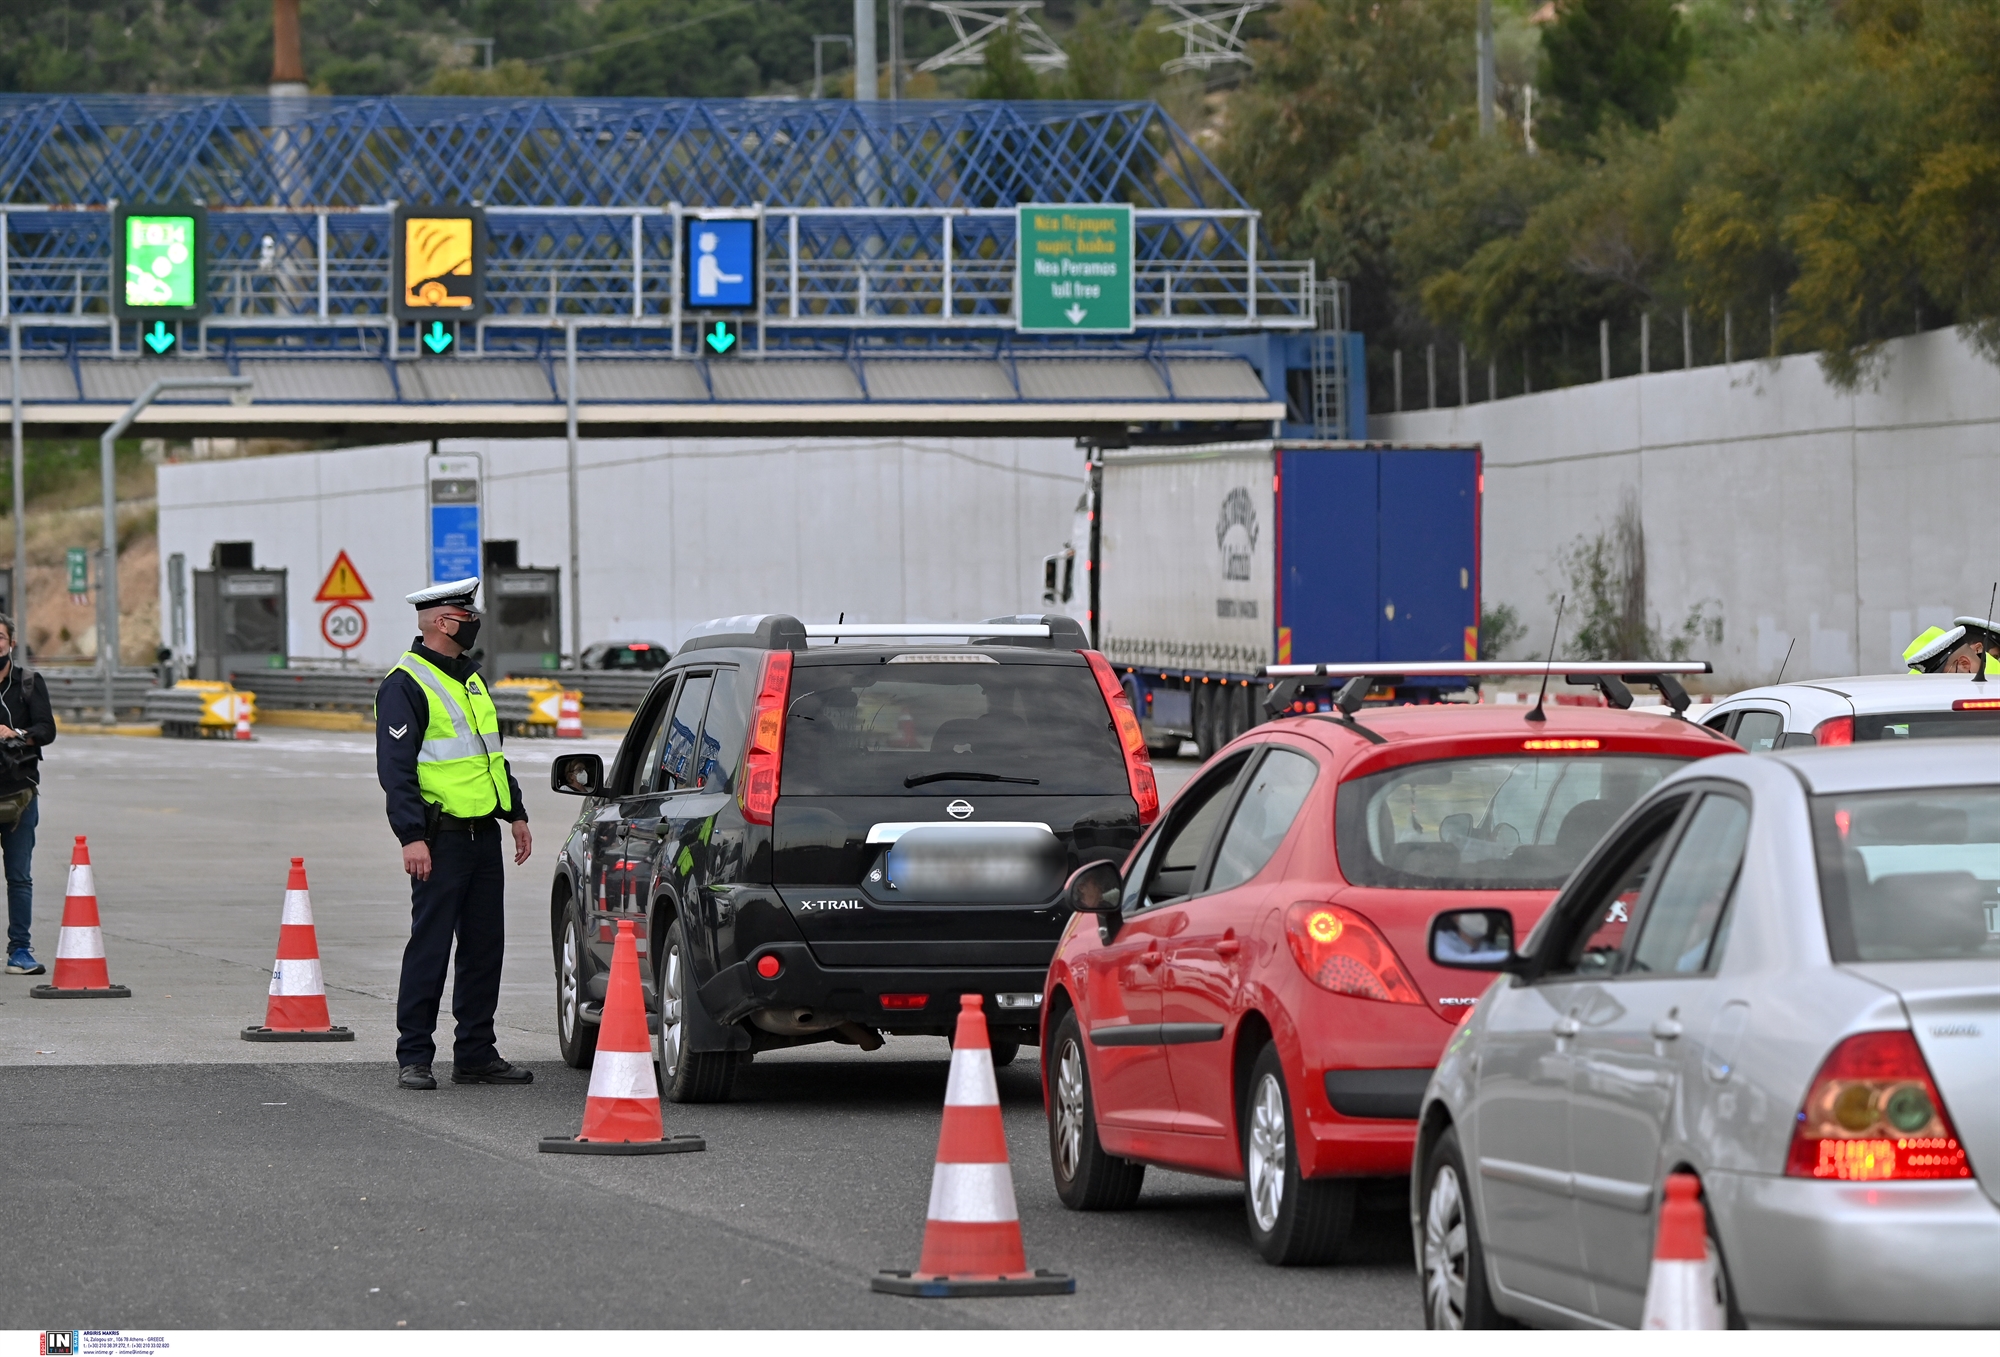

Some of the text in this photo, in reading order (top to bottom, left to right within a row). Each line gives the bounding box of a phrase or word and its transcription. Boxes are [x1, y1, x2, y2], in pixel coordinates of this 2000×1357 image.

[1034, 258, 1118, 277] Nea Peramos
[1051, 280, 1101, 299] toll free
[331, 616, 359, 636] 20
[800, 900, 864, 910] X-TRAIL
